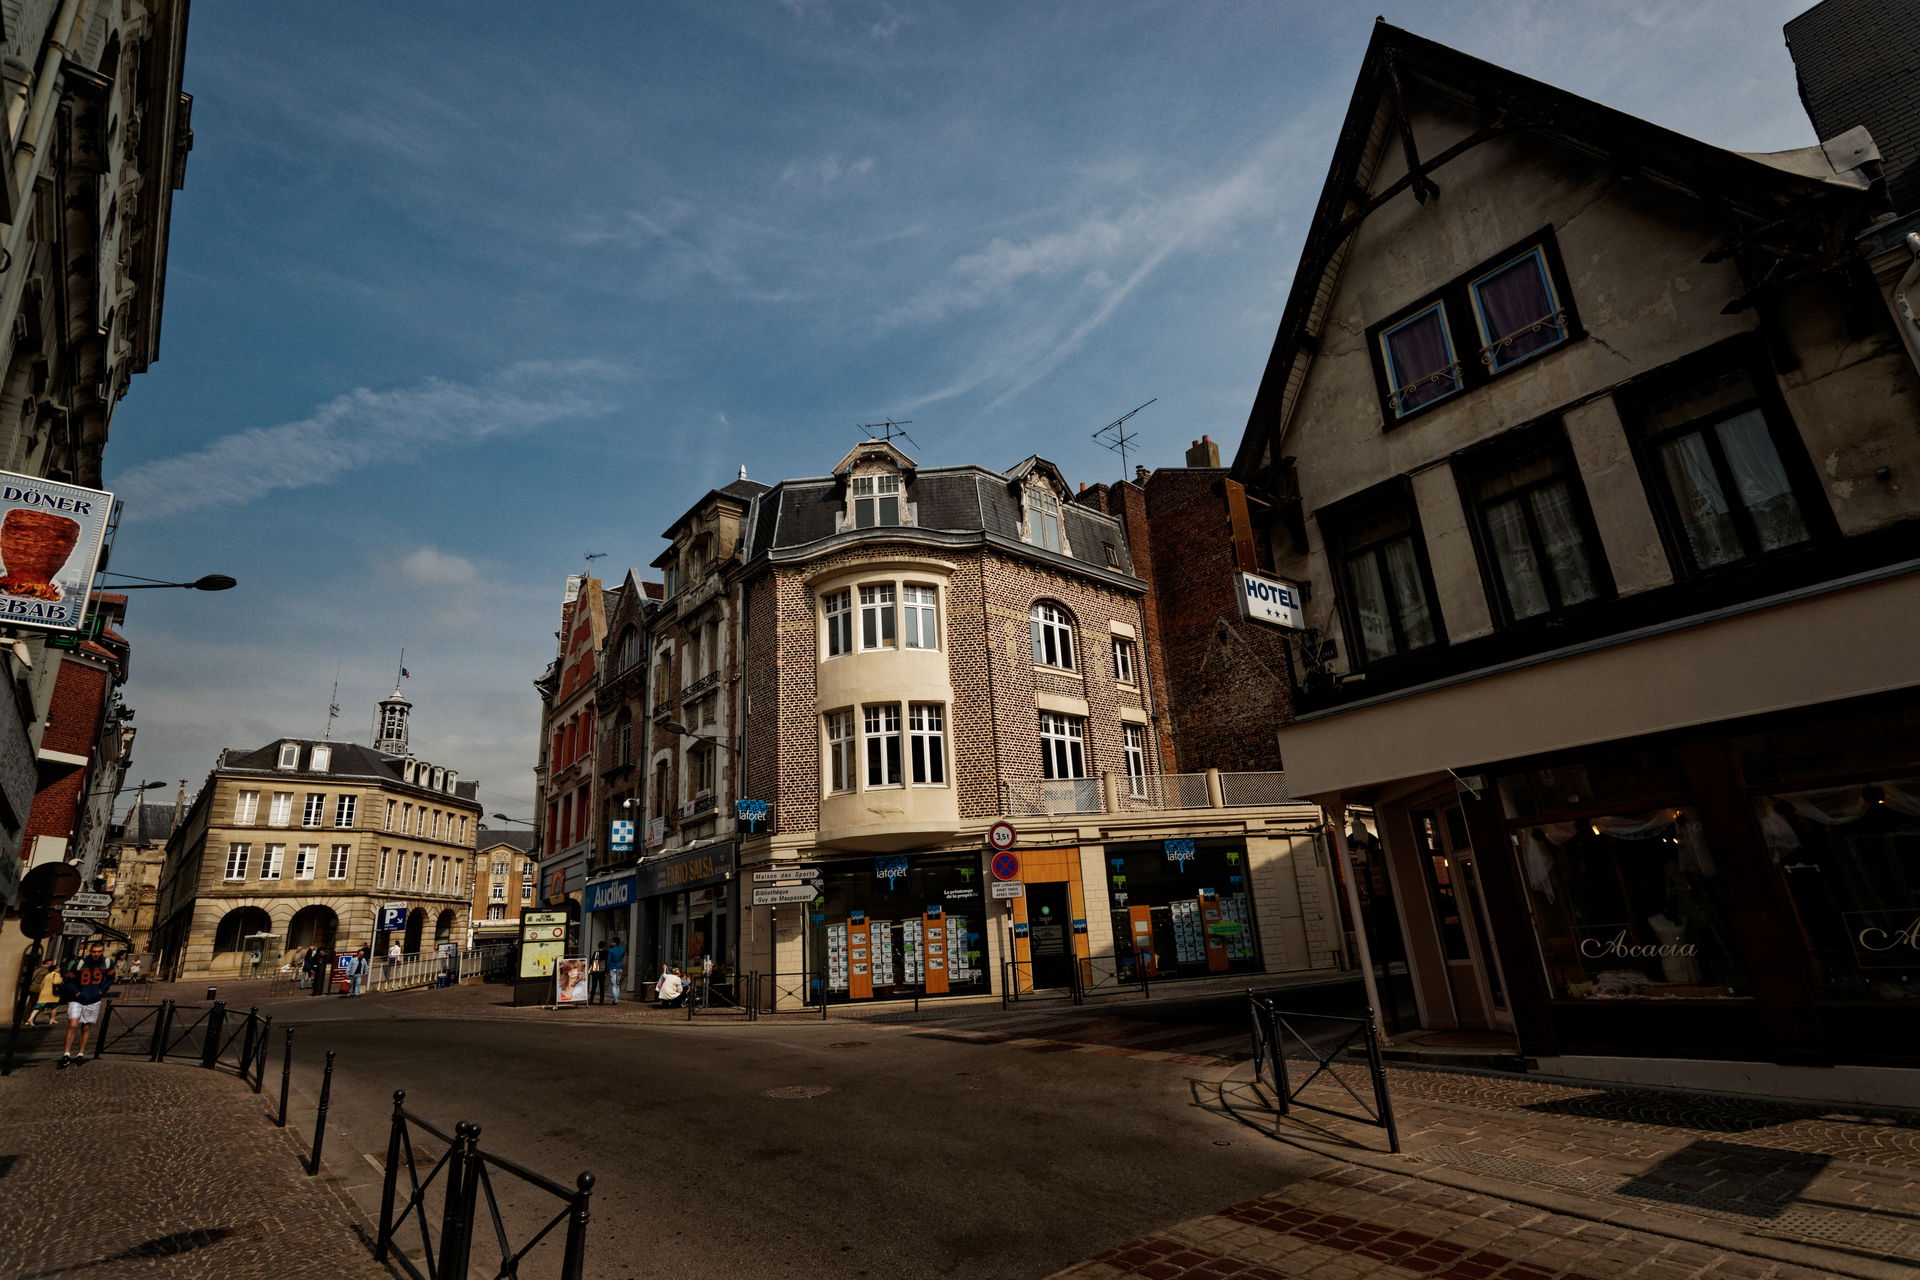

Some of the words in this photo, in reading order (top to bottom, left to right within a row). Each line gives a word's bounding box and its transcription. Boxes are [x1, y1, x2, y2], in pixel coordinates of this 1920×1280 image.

[3, 486, 92, 515] DÖNER
[1245, 578, 1299, 610] HOTEL
[738, 810, 766, 822] laforêt
[1166, 850, 1195, 862] laforêt
[665, 861, 688, 886] FABIO
[688, 856, 715, 880] SALSA
[794, 870, 816, 879] Sports
[876, 867, 907, 879] laforêt
[594, 882, 628, 908] Audika
[755, 889, 789, 897] Bibliothèque
[779, 894, 812, 902] Maupassant
[385, 909, 398, 924] P
[1580, 928, 1699, 959] Acacia
